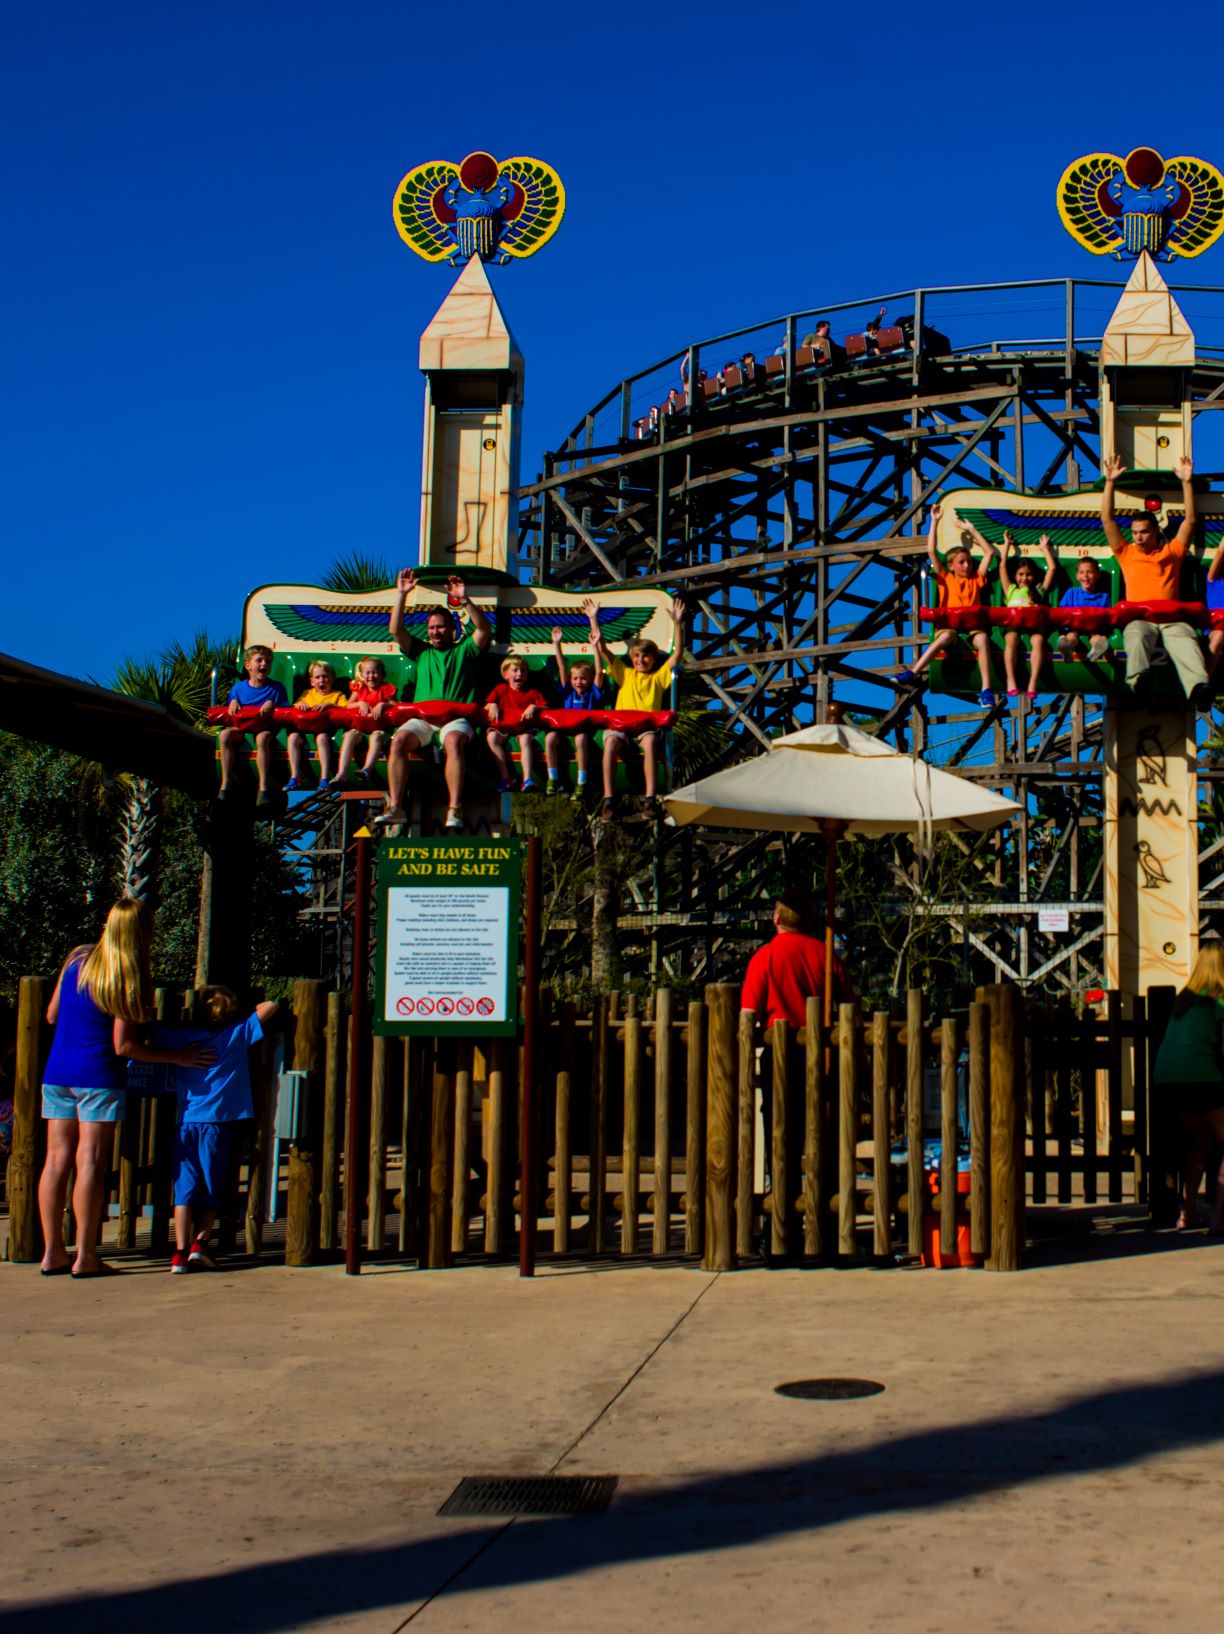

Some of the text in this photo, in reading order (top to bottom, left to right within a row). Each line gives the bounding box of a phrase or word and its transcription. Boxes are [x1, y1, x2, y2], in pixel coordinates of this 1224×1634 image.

[388, 847, 511, 860] LET'S HAVE FUN
[397, 863, 500, 876] AND BE SAFE
